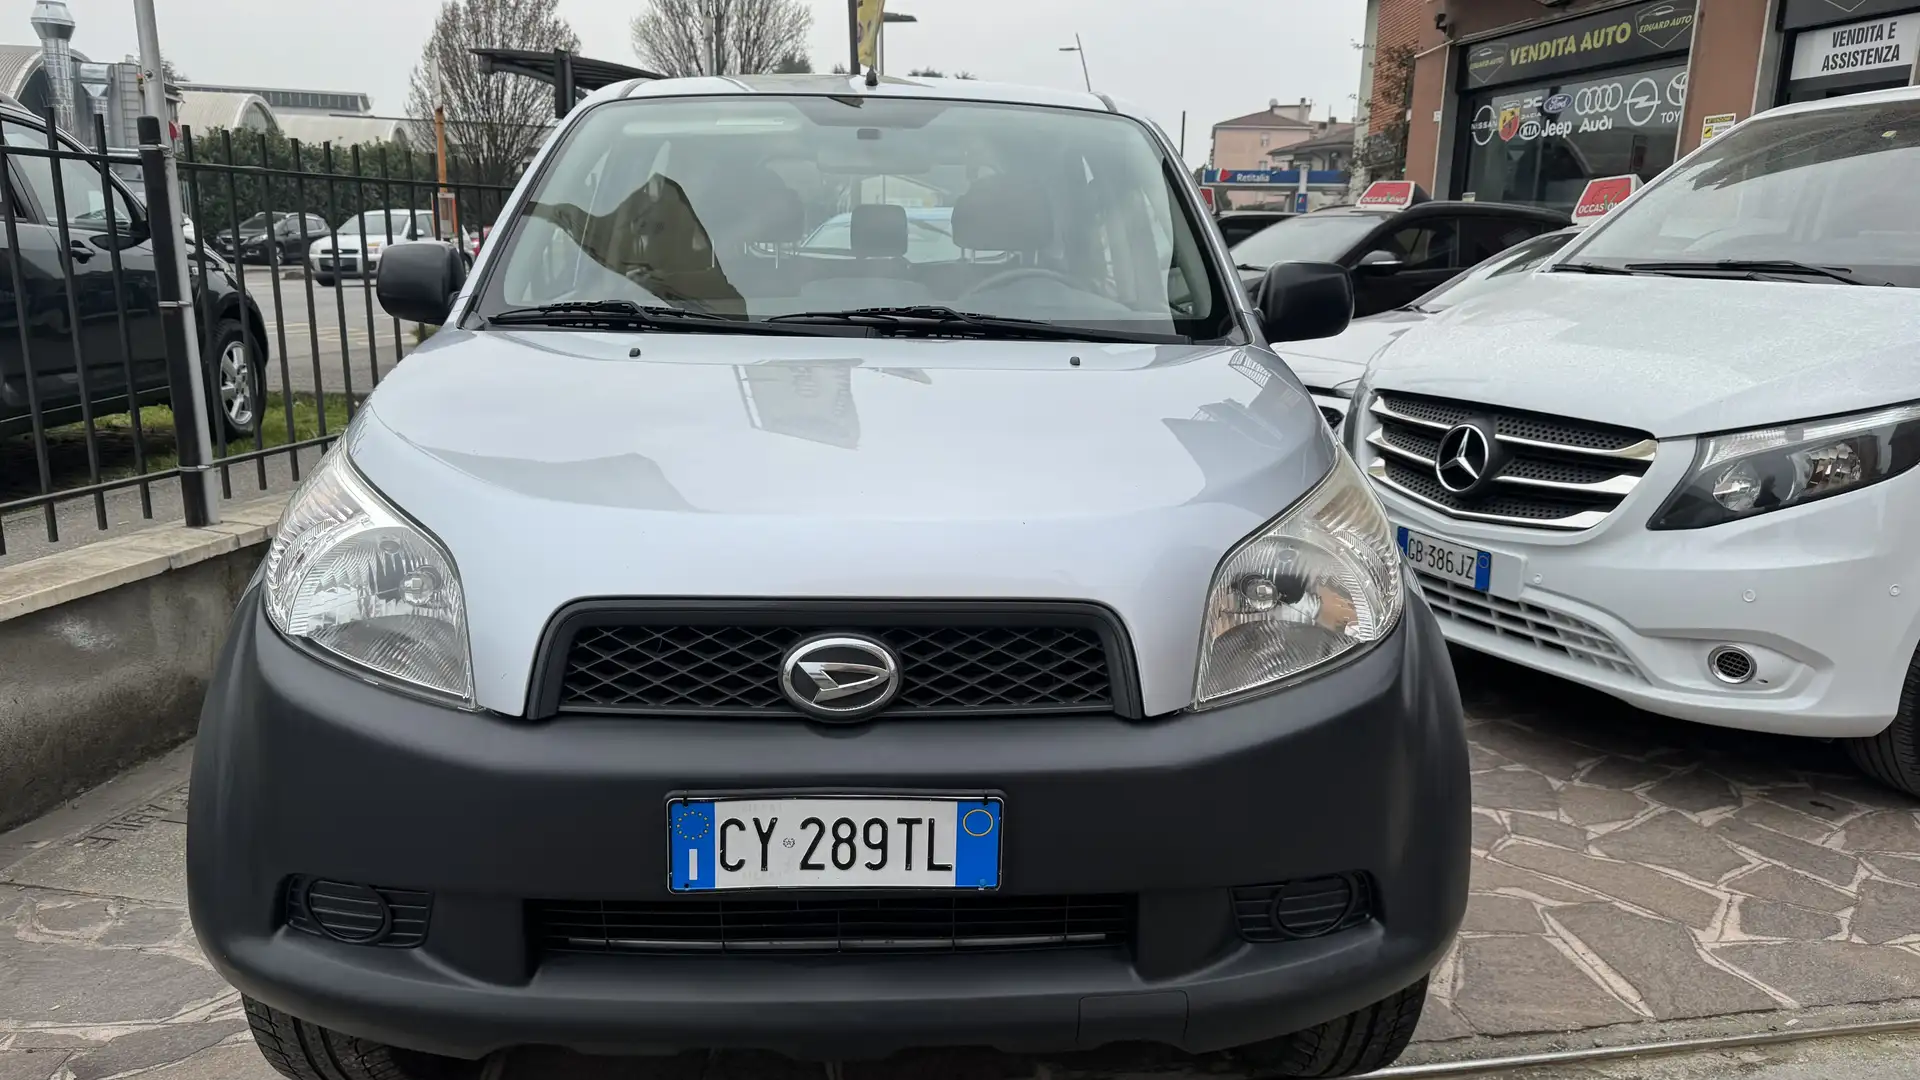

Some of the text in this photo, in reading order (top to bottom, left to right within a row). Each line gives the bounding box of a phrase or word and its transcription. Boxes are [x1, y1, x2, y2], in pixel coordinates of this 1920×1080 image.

[1640, 15, 1692, 33] EDUARD AUTO
[1510, 22, 1631, 66] VENDITA AUTO
[1832, 22, 1897, 48] VENDITA E
[1821, 44, 1900, 72] ASSISTENZA
[1548, 96, 1568, 111] Ford
[1471, 120, 1498, 130] NISSAN
[1521, 112, 1542, 120] DACIA
[1579, 115, 1613, 133] Audi
[1522, 124, 1537, 136] KIA
[1541, 119, 1572, 138] Jeep
[1236, 173, 1270, 182] Retitalia
[1408, 538, 1475, 580] GB 386JZ
[720, 817, 778, 872] CY
[799, 817, 953, 872] 289TL
